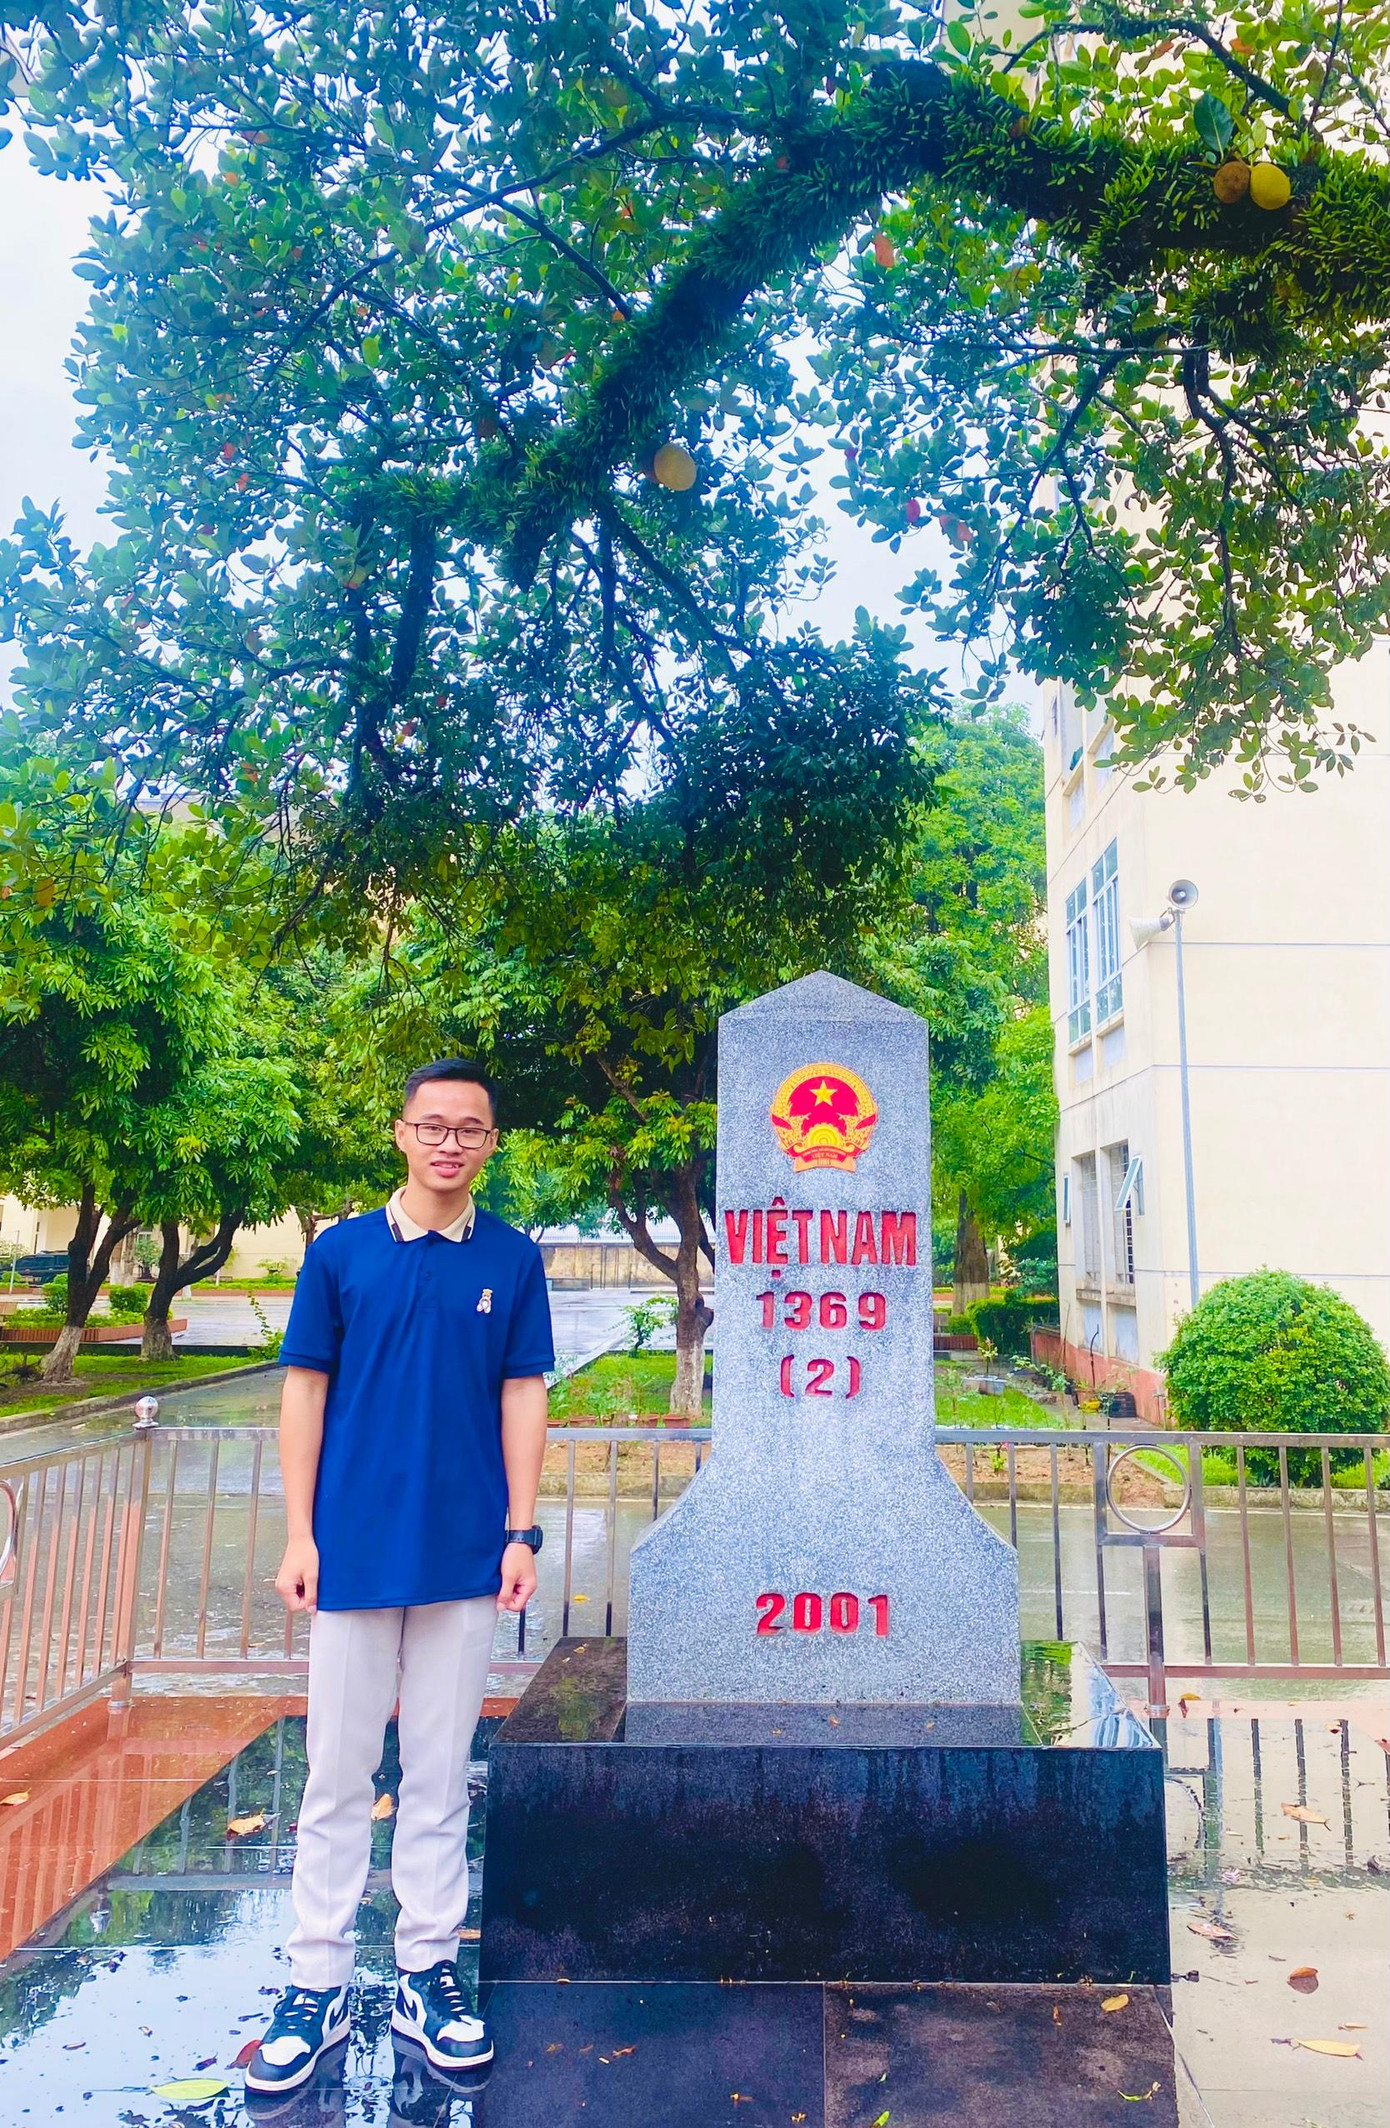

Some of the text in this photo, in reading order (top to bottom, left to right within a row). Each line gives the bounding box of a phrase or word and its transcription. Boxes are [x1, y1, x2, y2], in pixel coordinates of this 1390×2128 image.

[820, 1210, 917, 1266] NAM
[756, 1291, 888, 1331] 1369
[780, 1354, 862, 1399] (2)
[755, 1592, 890, 1637] 2001
